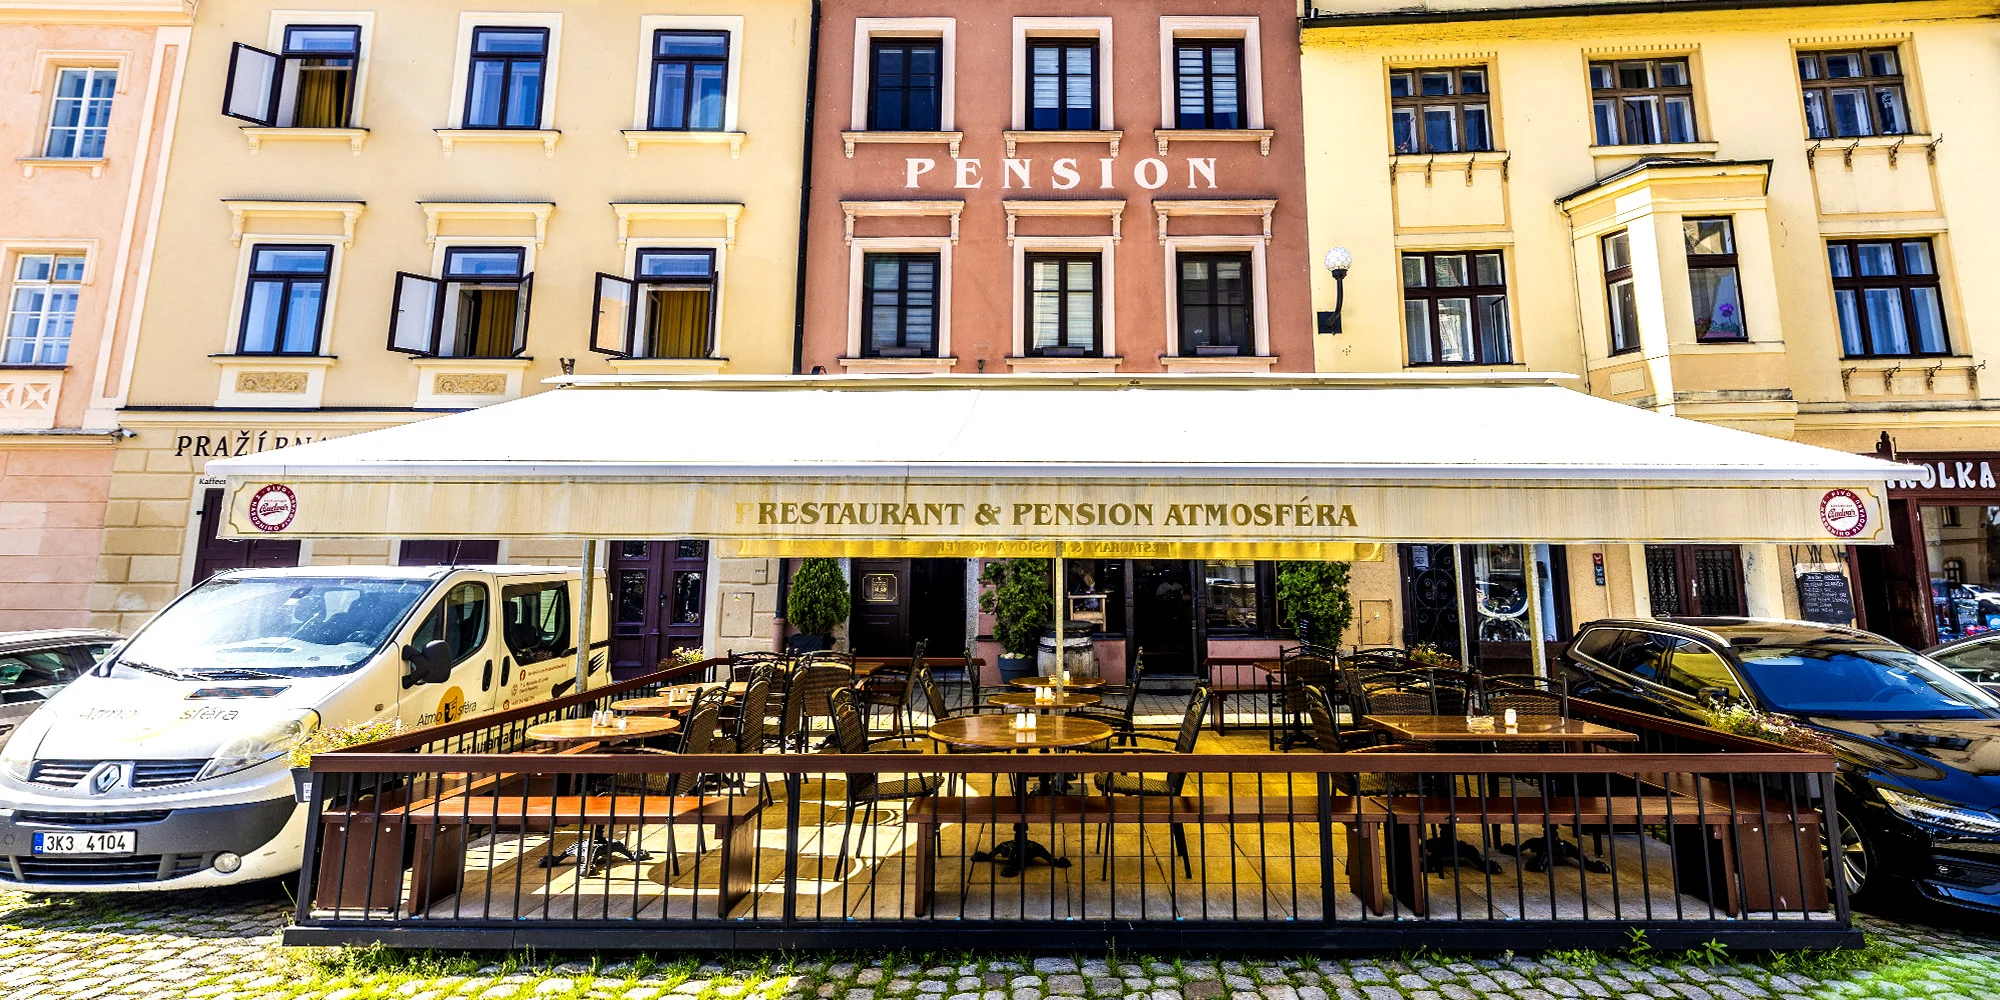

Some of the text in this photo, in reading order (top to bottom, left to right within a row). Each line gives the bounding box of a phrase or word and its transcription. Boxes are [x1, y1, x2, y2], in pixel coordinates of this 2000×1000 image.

[904, 157, 1218, 189] PENSION
[974, 504, 1002, 525] &
[1012, 503, 1154, 526] PENSION
[1163, 496, 1359, 526] ATMOSFÉRA
[416, 700, 477, 727] Atmo sféra
[46, 835, 126, 851] 3K3 4104
